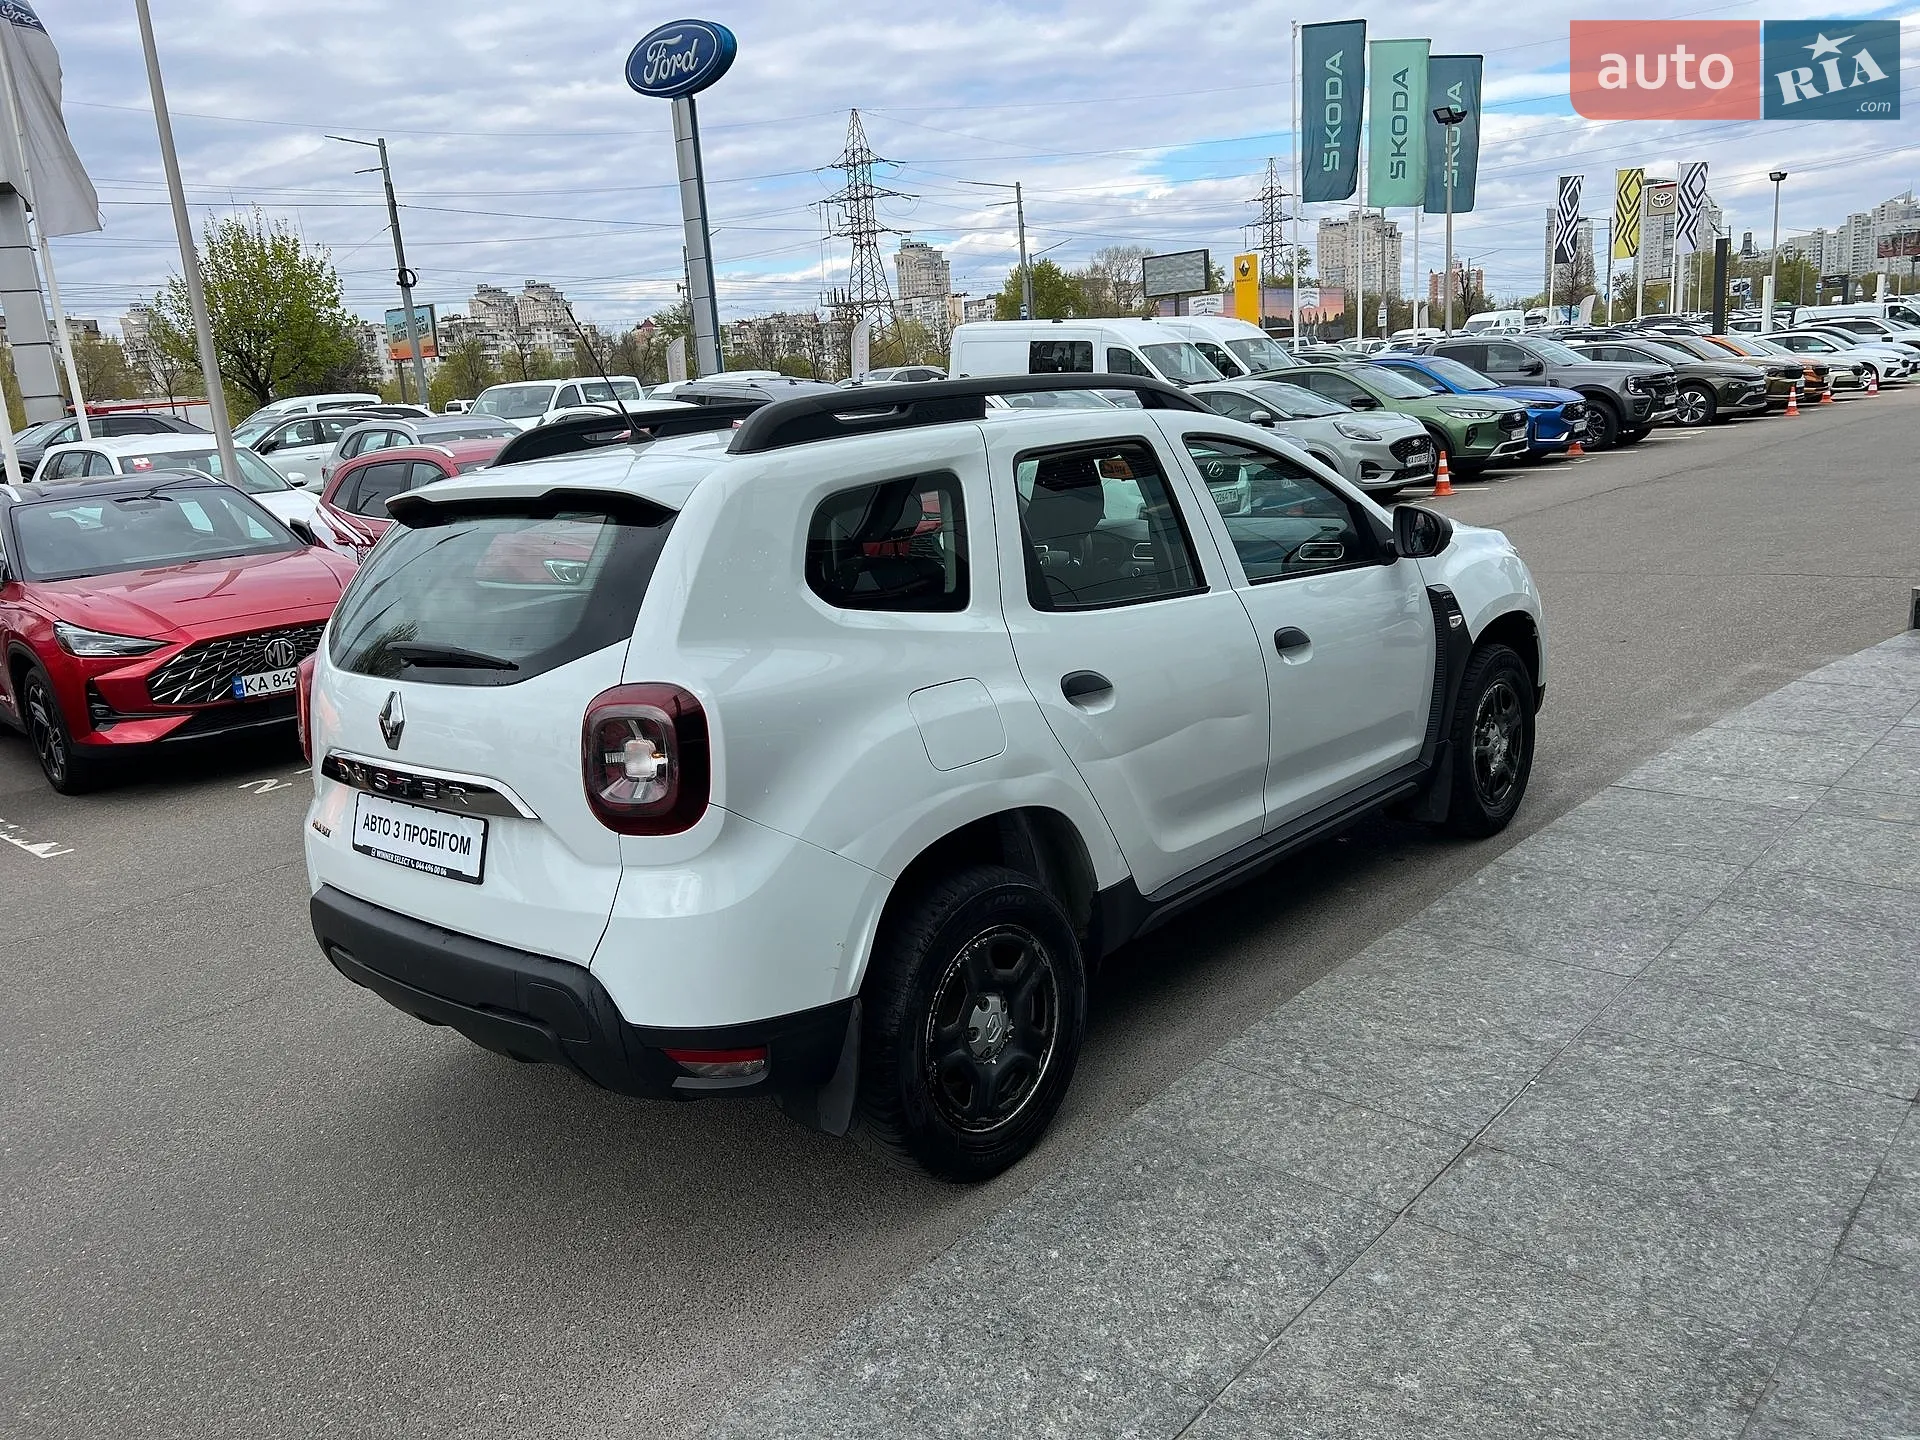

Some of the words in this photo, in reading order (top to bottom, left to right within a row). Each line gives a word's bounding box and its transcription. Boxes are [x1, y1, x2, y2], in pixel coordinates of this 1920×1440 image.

[643, 34, 699, 85] Ford
[267, 641, 294, 667] MG
[244, 676, 269, 694] KA
[337, 761, 469, 806] DUSTER
[362, 812, 391, 837] АВТО
[403, 822, 471, 856] ПРОБІГОМ
[393, 854, 411, 866] SELECT
